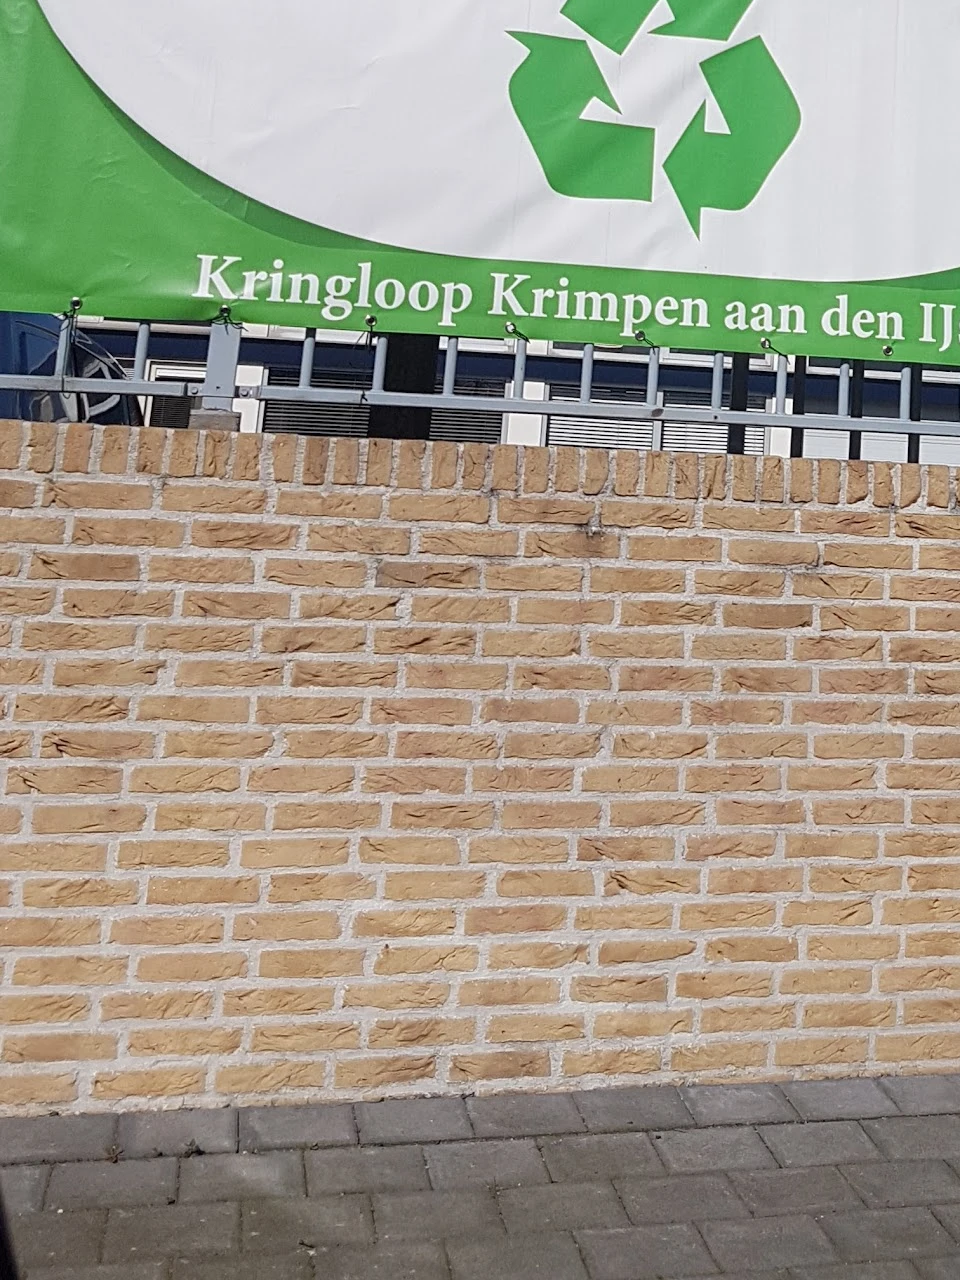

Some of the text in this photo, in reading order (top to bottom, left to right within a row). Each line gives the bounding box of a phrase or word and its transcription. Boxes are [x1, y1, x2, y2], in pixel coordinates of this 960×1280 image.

[191, 253, 473, 328] Kringloop
[487, 272, 711, 340] Krimpen
[724, 300, 808, 335] aan
[821, 294, 906, 341] den
